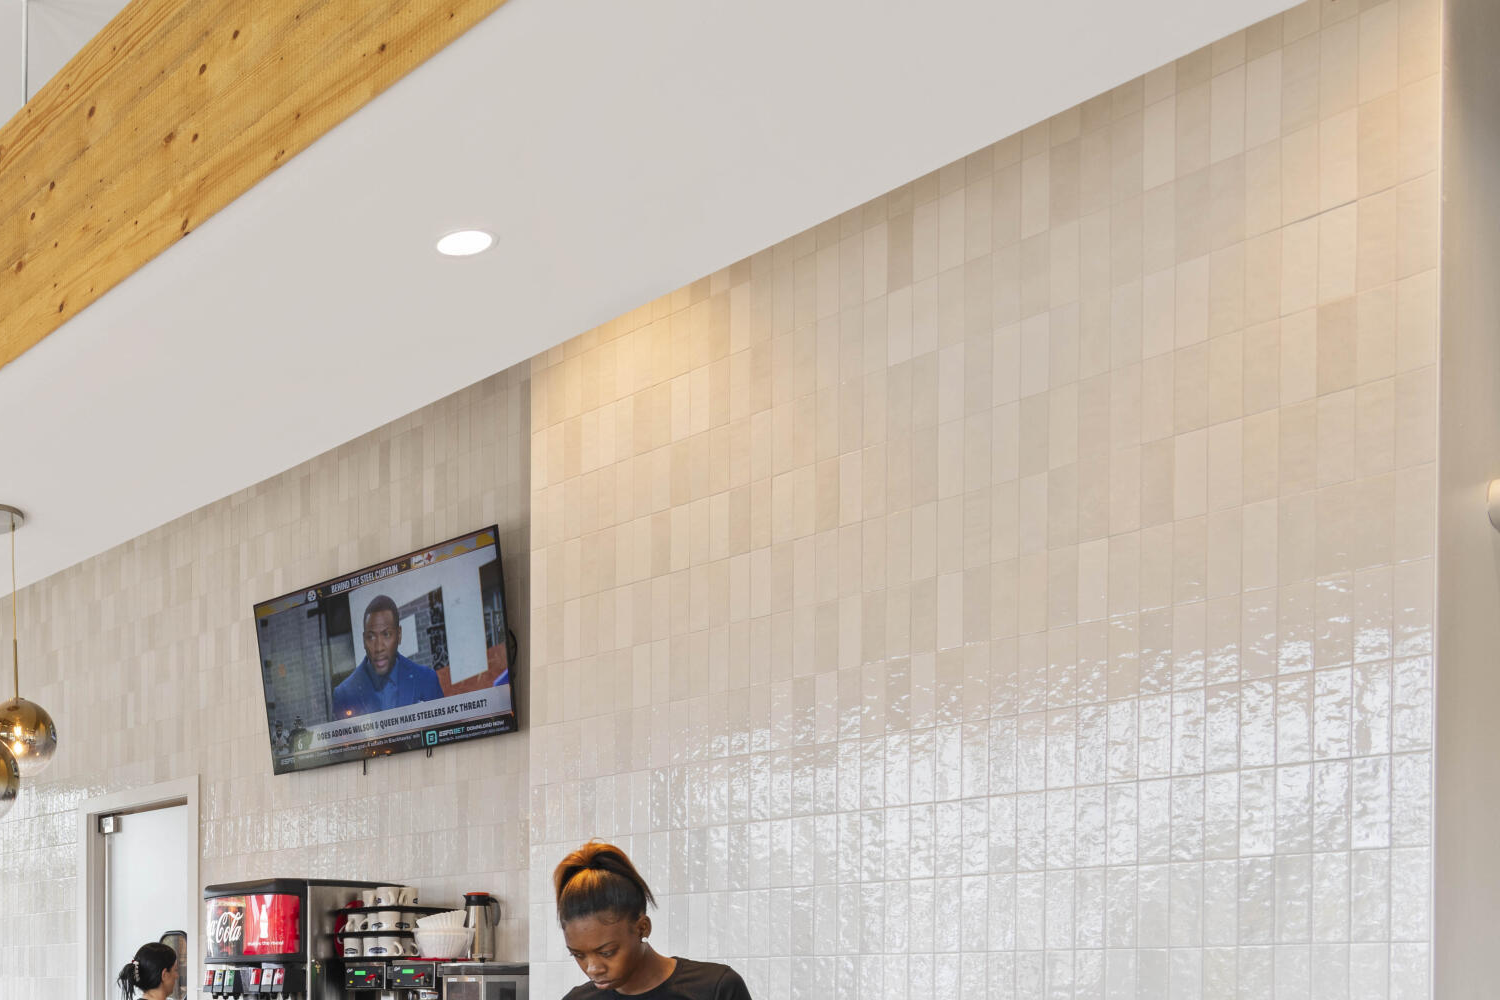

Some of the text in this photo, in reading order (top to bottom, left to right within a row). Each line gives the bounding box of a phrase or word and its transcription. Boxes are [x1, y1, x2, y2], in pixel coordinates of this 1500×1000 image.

[350, 576, 360, 588] THE
[360, 571, 375, 584] STEEL
[375, 564, 399, 579] CURTAIN
[317, 730, 331, 741] DOES
[332, 727, 353, 738] ADDING
[353, 721, 374, 734] WILSON
[380, 717, 399, 730] QUEEN
[400, 713, 416, 724] MAKE
[417, 707, 446, 721] STEELERS
[447, 705, 458, 715] AFC
[459, 698, 488, 711] THREAT?
